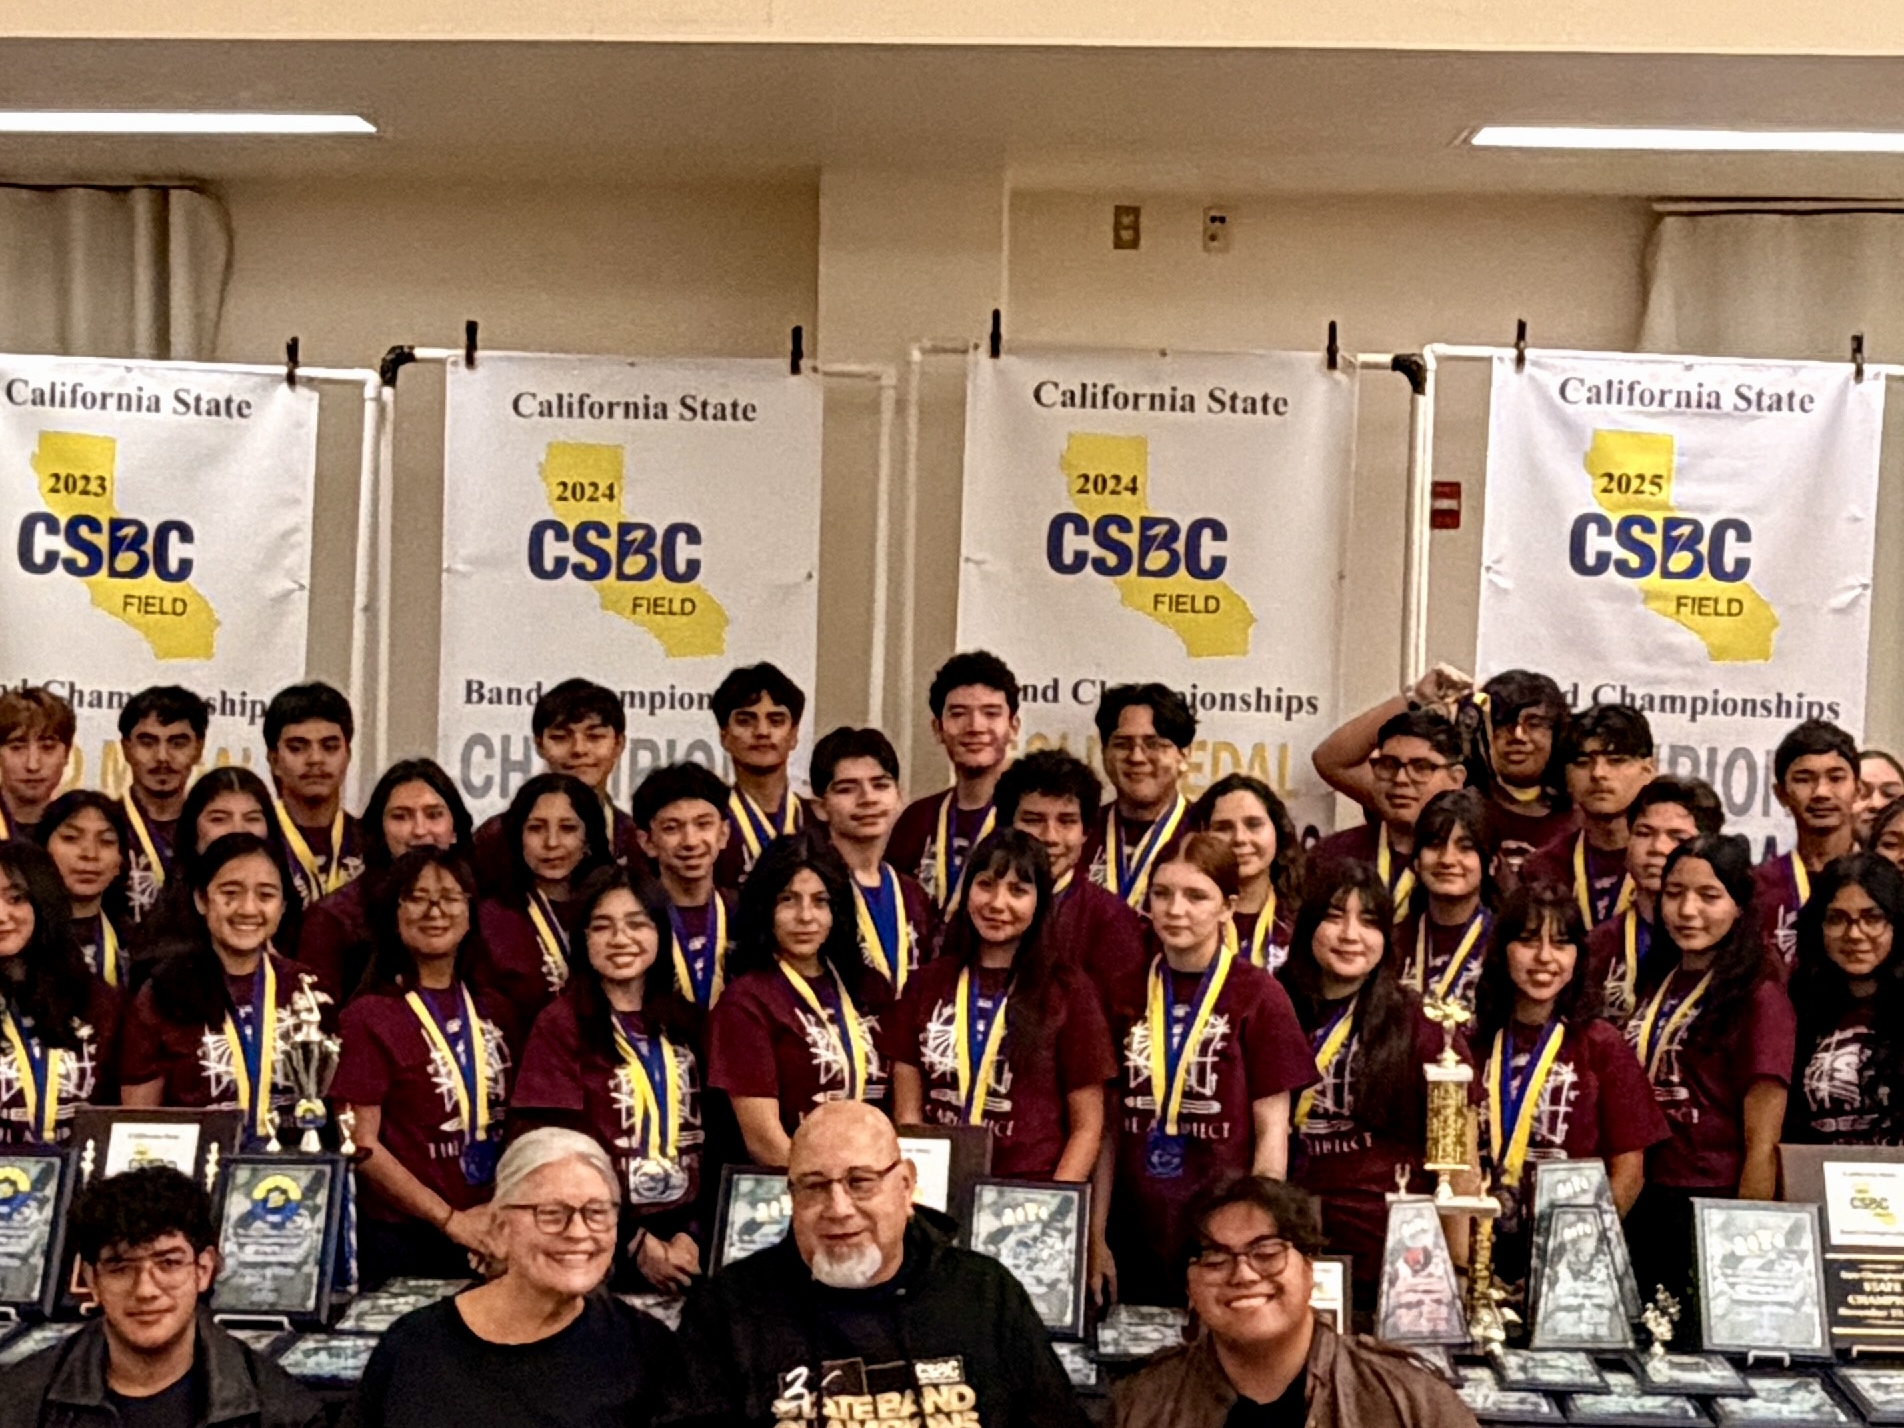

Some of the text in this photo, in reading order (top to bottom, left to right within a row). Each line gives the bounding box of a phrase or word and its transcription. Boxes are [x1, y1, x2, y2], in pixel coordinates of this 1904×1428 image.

[5, 379, 253, 419] California State
[512, 391, 758, 422] California State
[1033, 381, 1289, 416] California State
[1558, 377, 1815, 414] California State
[47, 473, 107, 496] 2023
[555, 481, 616, 502] 2024
[1076, 473, 1139, 495] 2024
[1600, 472, 1664, 495] 2025
[18, 512, 194, 582] CSBC
[528, 519, 702, 583] CSBC
[1047, 512, 1228, 580] CSBC
[1569, 512, 1752, 583] CSBC
[122, 594, 187, 616] FIELD
[631, 597, 696, 616] FIELD
[1152, 593, 1221, 614] FIELD
[1675, 596, 1744, 617] FIELD
[464, 679, 544, 707] Band
